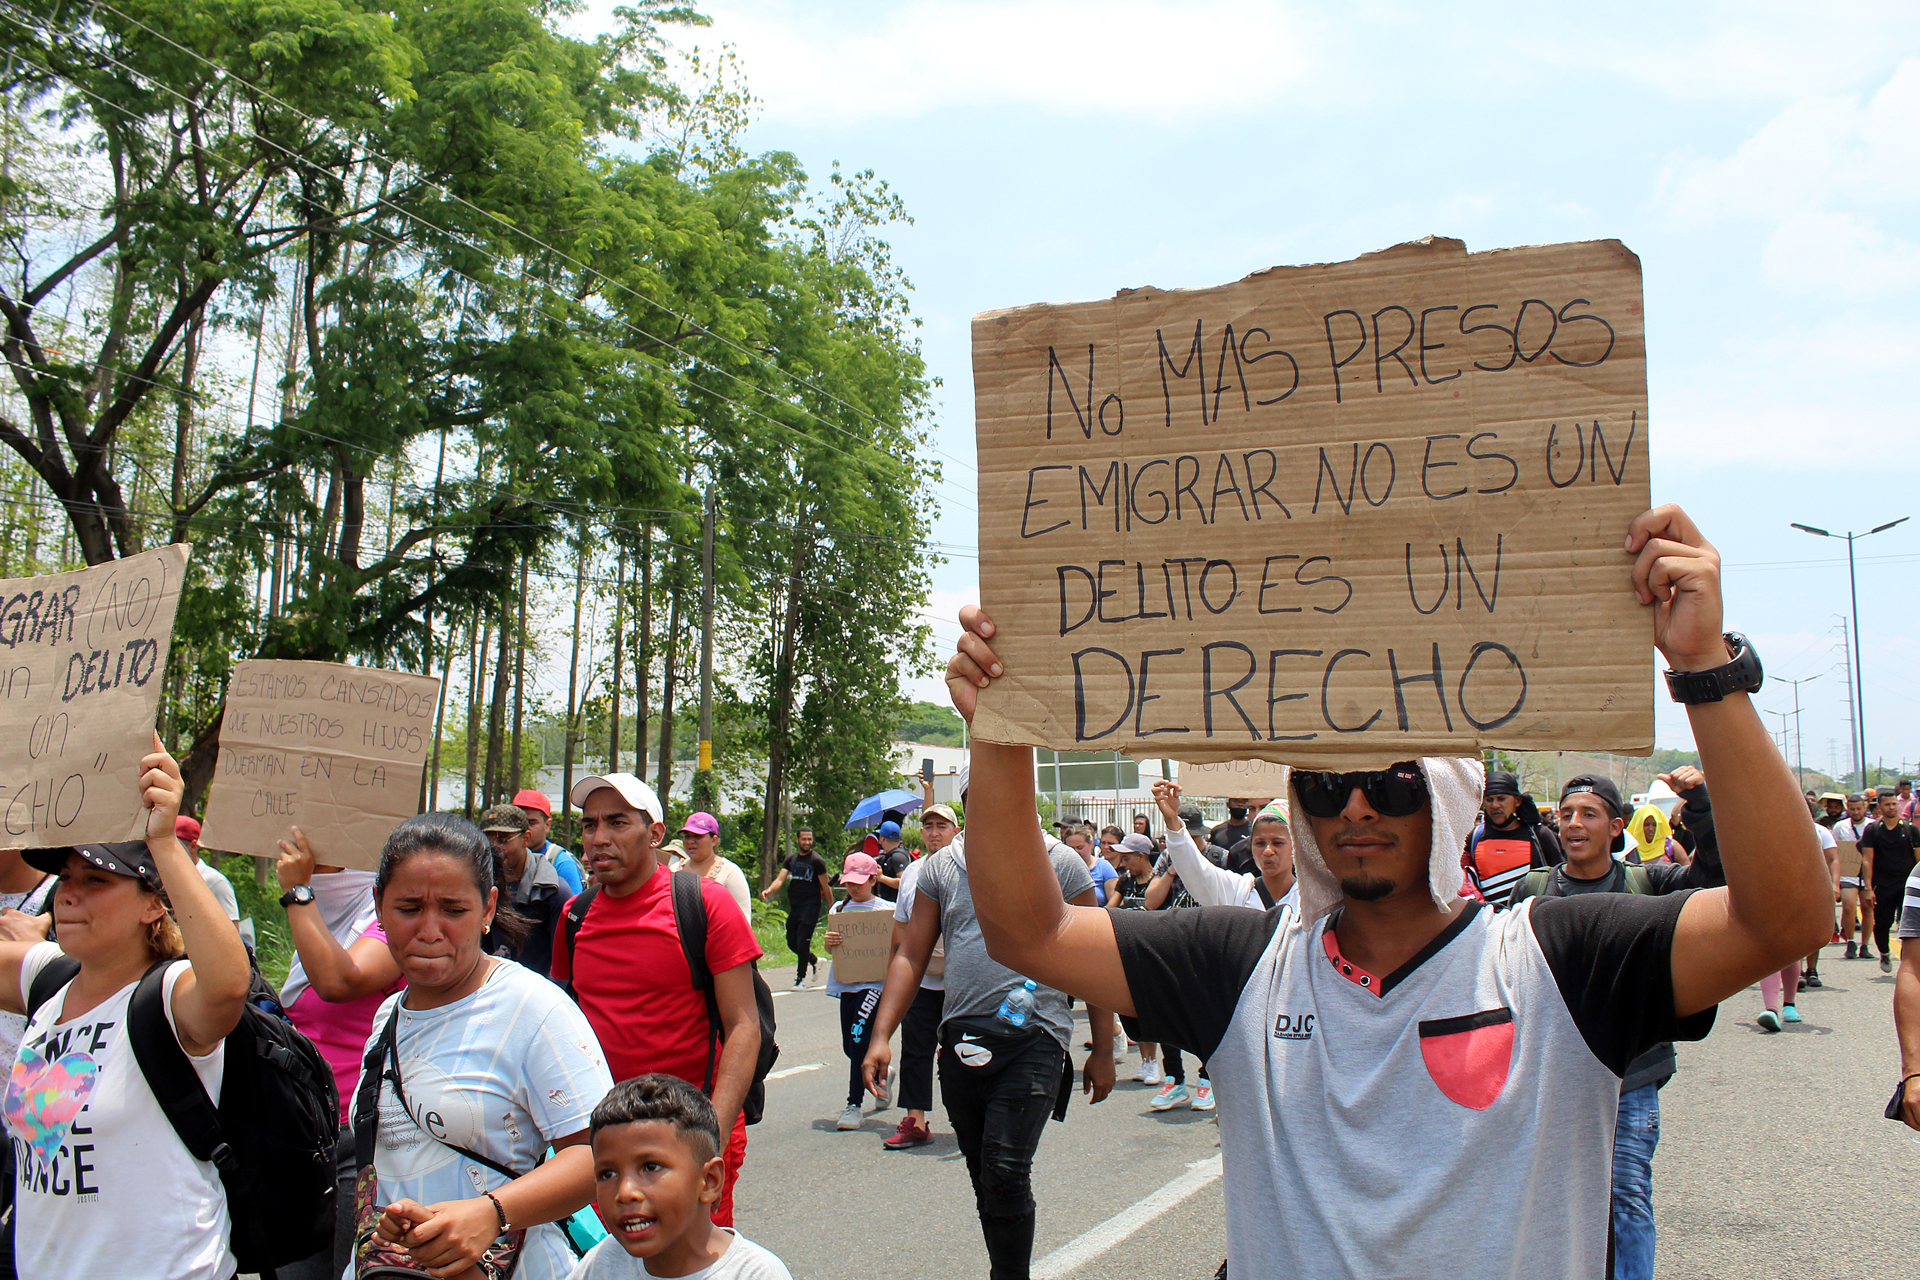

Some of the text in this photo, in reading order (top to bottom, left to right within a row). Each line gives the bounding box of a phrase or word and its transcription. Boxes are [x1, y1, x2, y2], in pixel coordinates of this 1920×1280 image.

[1046, 297, 1616, 440] No MAS PRESOS
[1020, 410, 1637, 539] EMIGRAR NO ES UN
[1056, 532, 1503, 638] DELITO ES UN
[0, 583, 81, 650] GRAR
[235, 666, 434, 719] ESTAMOS CANSADOS
[1070, 639, 1528, 744] DERECHO
[259, 712, 345, 739] NUESTROS
[362, 719, 423, 754] HIJOS
[0, 752, 109, 837] CHO"
[224, 747, 387, 789] DUERMAN EN LA
[250, 788, 298, 818] CALLE
[841, 944, 892, 960] Dominican
[857, 988, 883, 1020] LADI
[1275, 1014, 1315, 1033] DJC
